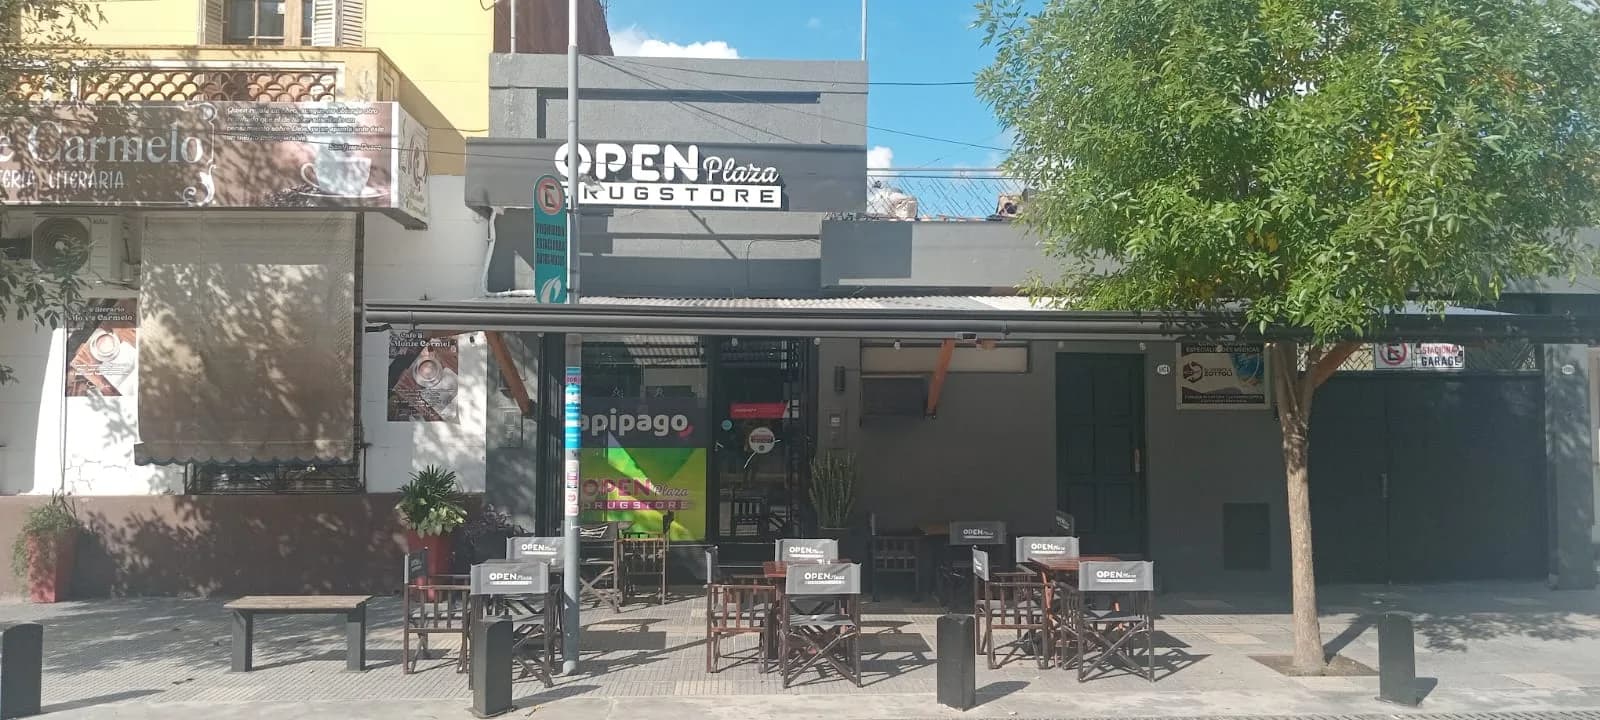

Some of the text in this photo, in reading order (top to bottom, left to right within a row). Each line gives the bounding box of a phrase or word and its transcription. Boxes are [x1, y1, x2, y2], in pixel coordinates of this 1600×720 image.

[28, 118, 203, 163] Carmelo
[554, 142, 779, 184] OPEN Plaza
[0, 170, 125, 189] ERIA LITERARIA
[560, 185, 774, 203] RUGSTORE
[1421, 356, 1459, 366] GARAGE
[580, 408, 688, 436] apipago
[583, 479, 689, 497] OPEN Plaza
[804, 572, 830, 580] OPEN
[1096, 570, 1122, 578] OPEN
